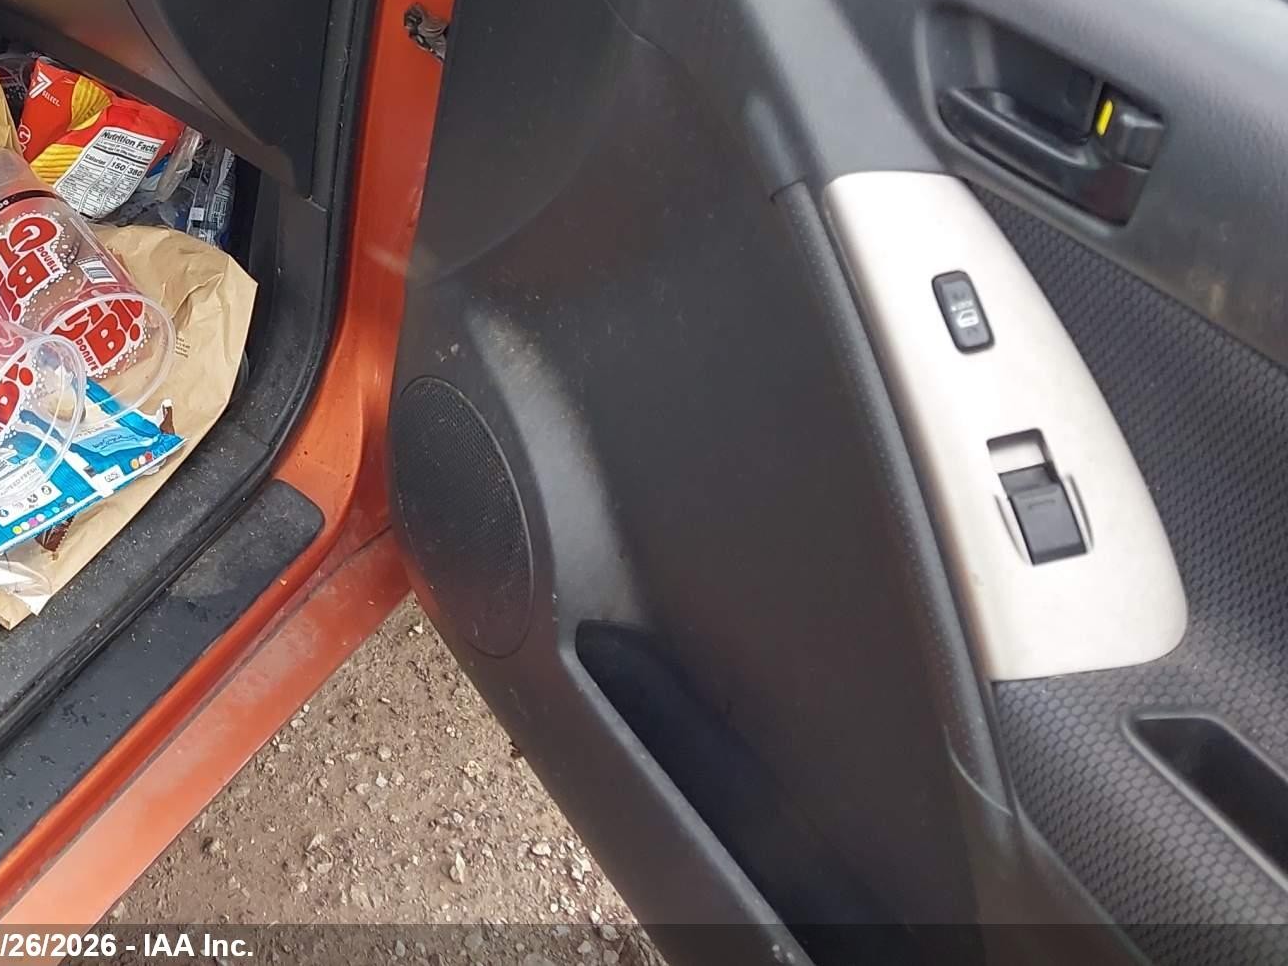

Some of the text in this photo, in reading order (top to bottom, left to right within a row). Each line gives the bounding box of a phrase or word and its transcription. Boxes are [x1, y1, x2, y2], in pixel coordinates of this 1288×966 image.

[102, 131, 136, 148] Nutrition
[136, 141, 158, 153] Facts
[112, 161, 127, 172] 150
[36, 245, 61, 274] DOUBLE
